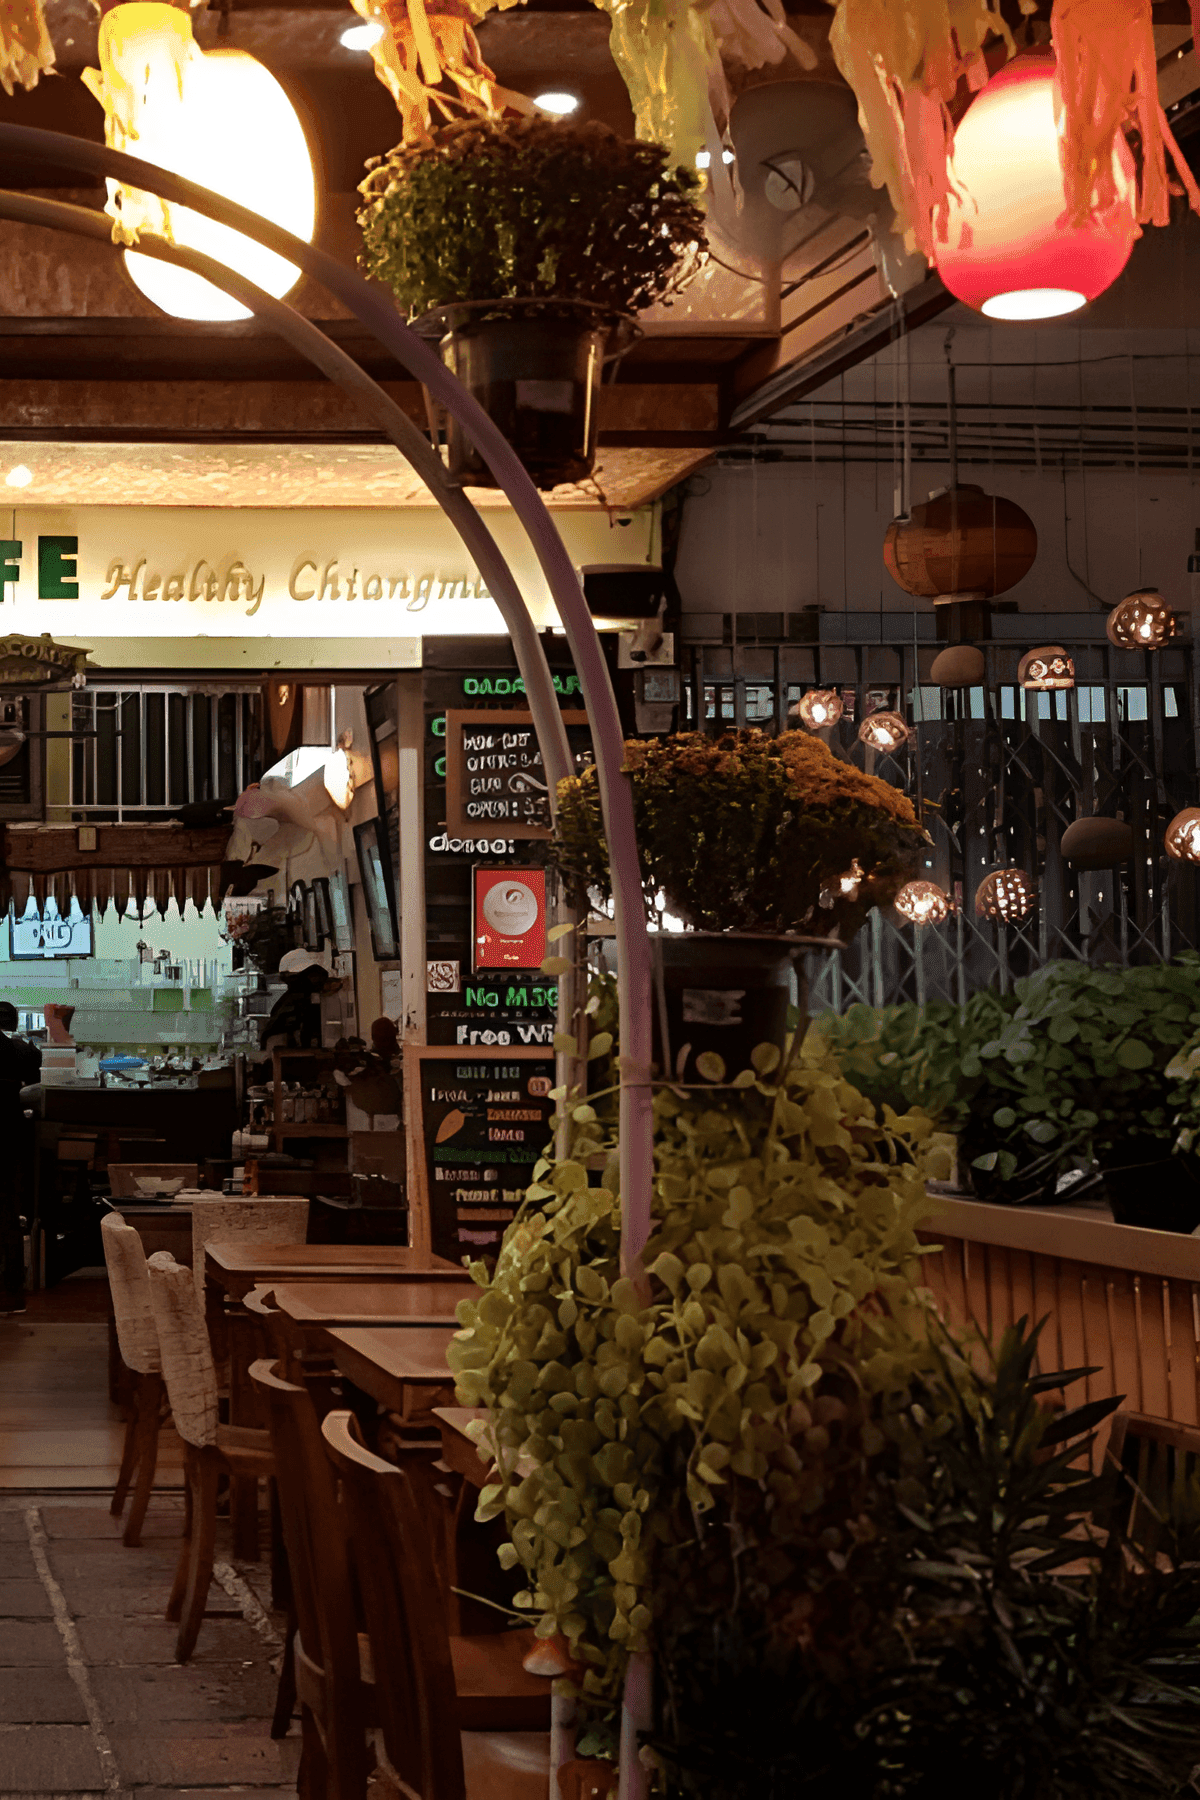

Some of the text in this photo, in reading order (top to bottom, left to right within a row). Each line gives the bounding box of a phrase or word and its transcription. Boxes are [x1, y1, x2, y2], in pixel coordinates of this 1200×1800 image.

[100, 559, 266, 616] Healthy
[465, 986, 499, 1008] No
[456, 1024, 555, 1046] Free Wi
